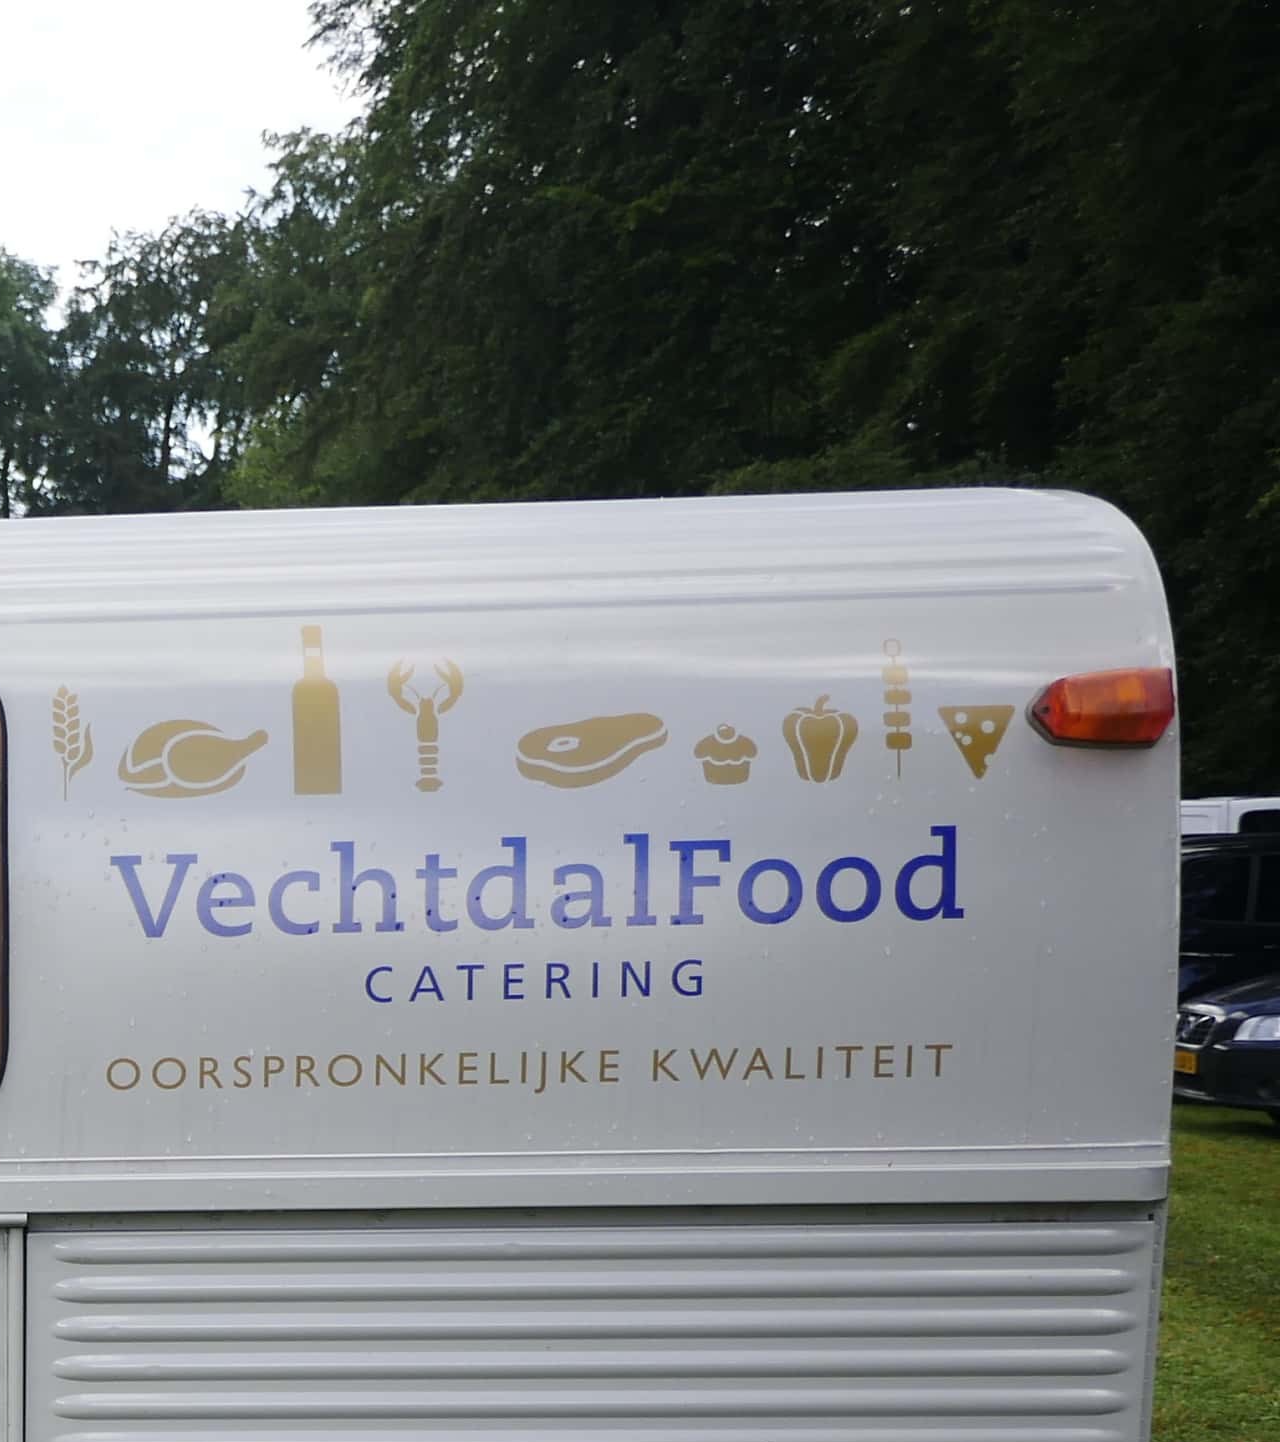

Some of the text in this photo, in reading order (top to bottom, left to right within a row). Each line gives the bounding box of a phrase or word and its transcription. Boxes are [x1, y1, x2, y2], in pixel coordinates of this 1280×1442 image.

[109, 823, 967, 940] VechtdalFood
[364, 958, 706, 1004] CATERING
[105, 1043, 954, 1095] OORSPRONKELIJKE KWALITEIT
